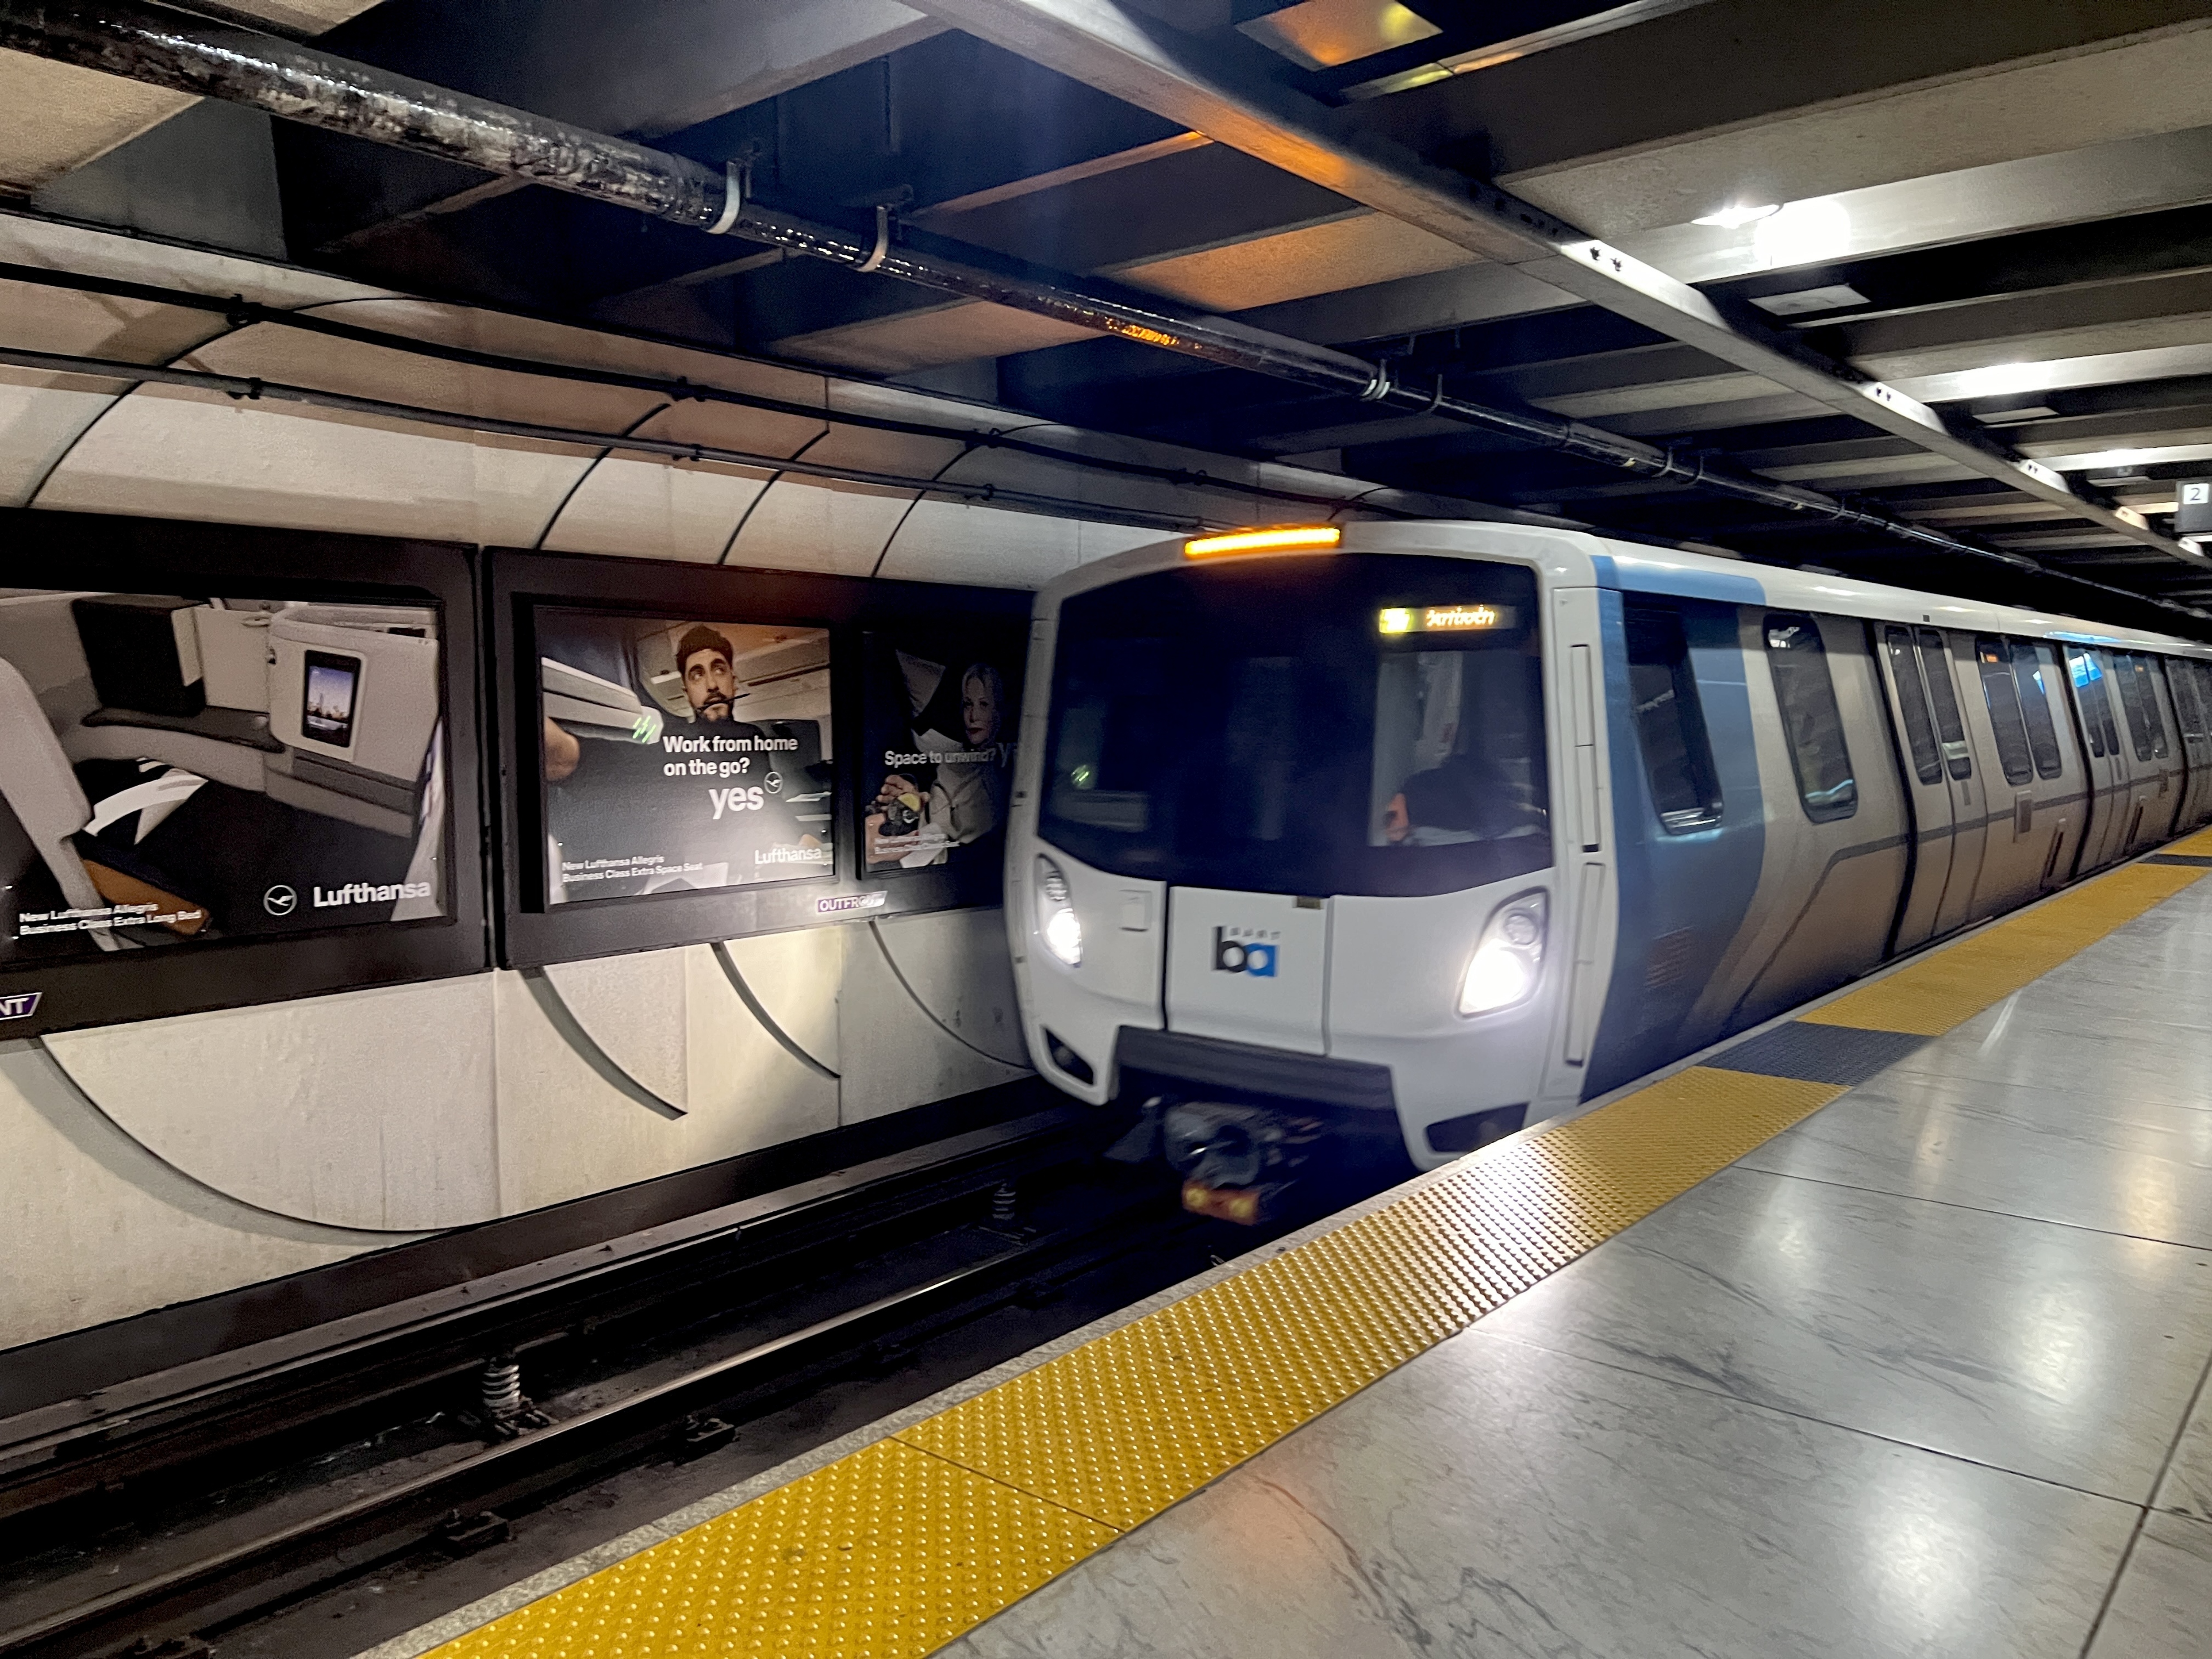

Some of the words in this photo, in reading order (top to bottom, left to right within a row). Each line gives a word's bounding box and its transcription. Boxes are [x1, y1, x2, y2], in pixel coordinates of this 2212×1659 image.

[2190, 488, 2200, 501] 2
[663, 736, 711, 753] Work
[712, 735, 752, 752] from
[754, 735, 798, 751] home
[664, 763, 686, 776] on
[688, 759, 717, 775] the
[719, 757, 750, 778] go?
[885, 751, 927, 768] Space
[929, 751, 941, 763] to
[709, 786, 764, 819] yes
[755, 848, 822, 864] Lufthansa
[313, 882, 431, 907] Lufthansa
[0, 998, 29, 1015] NT
